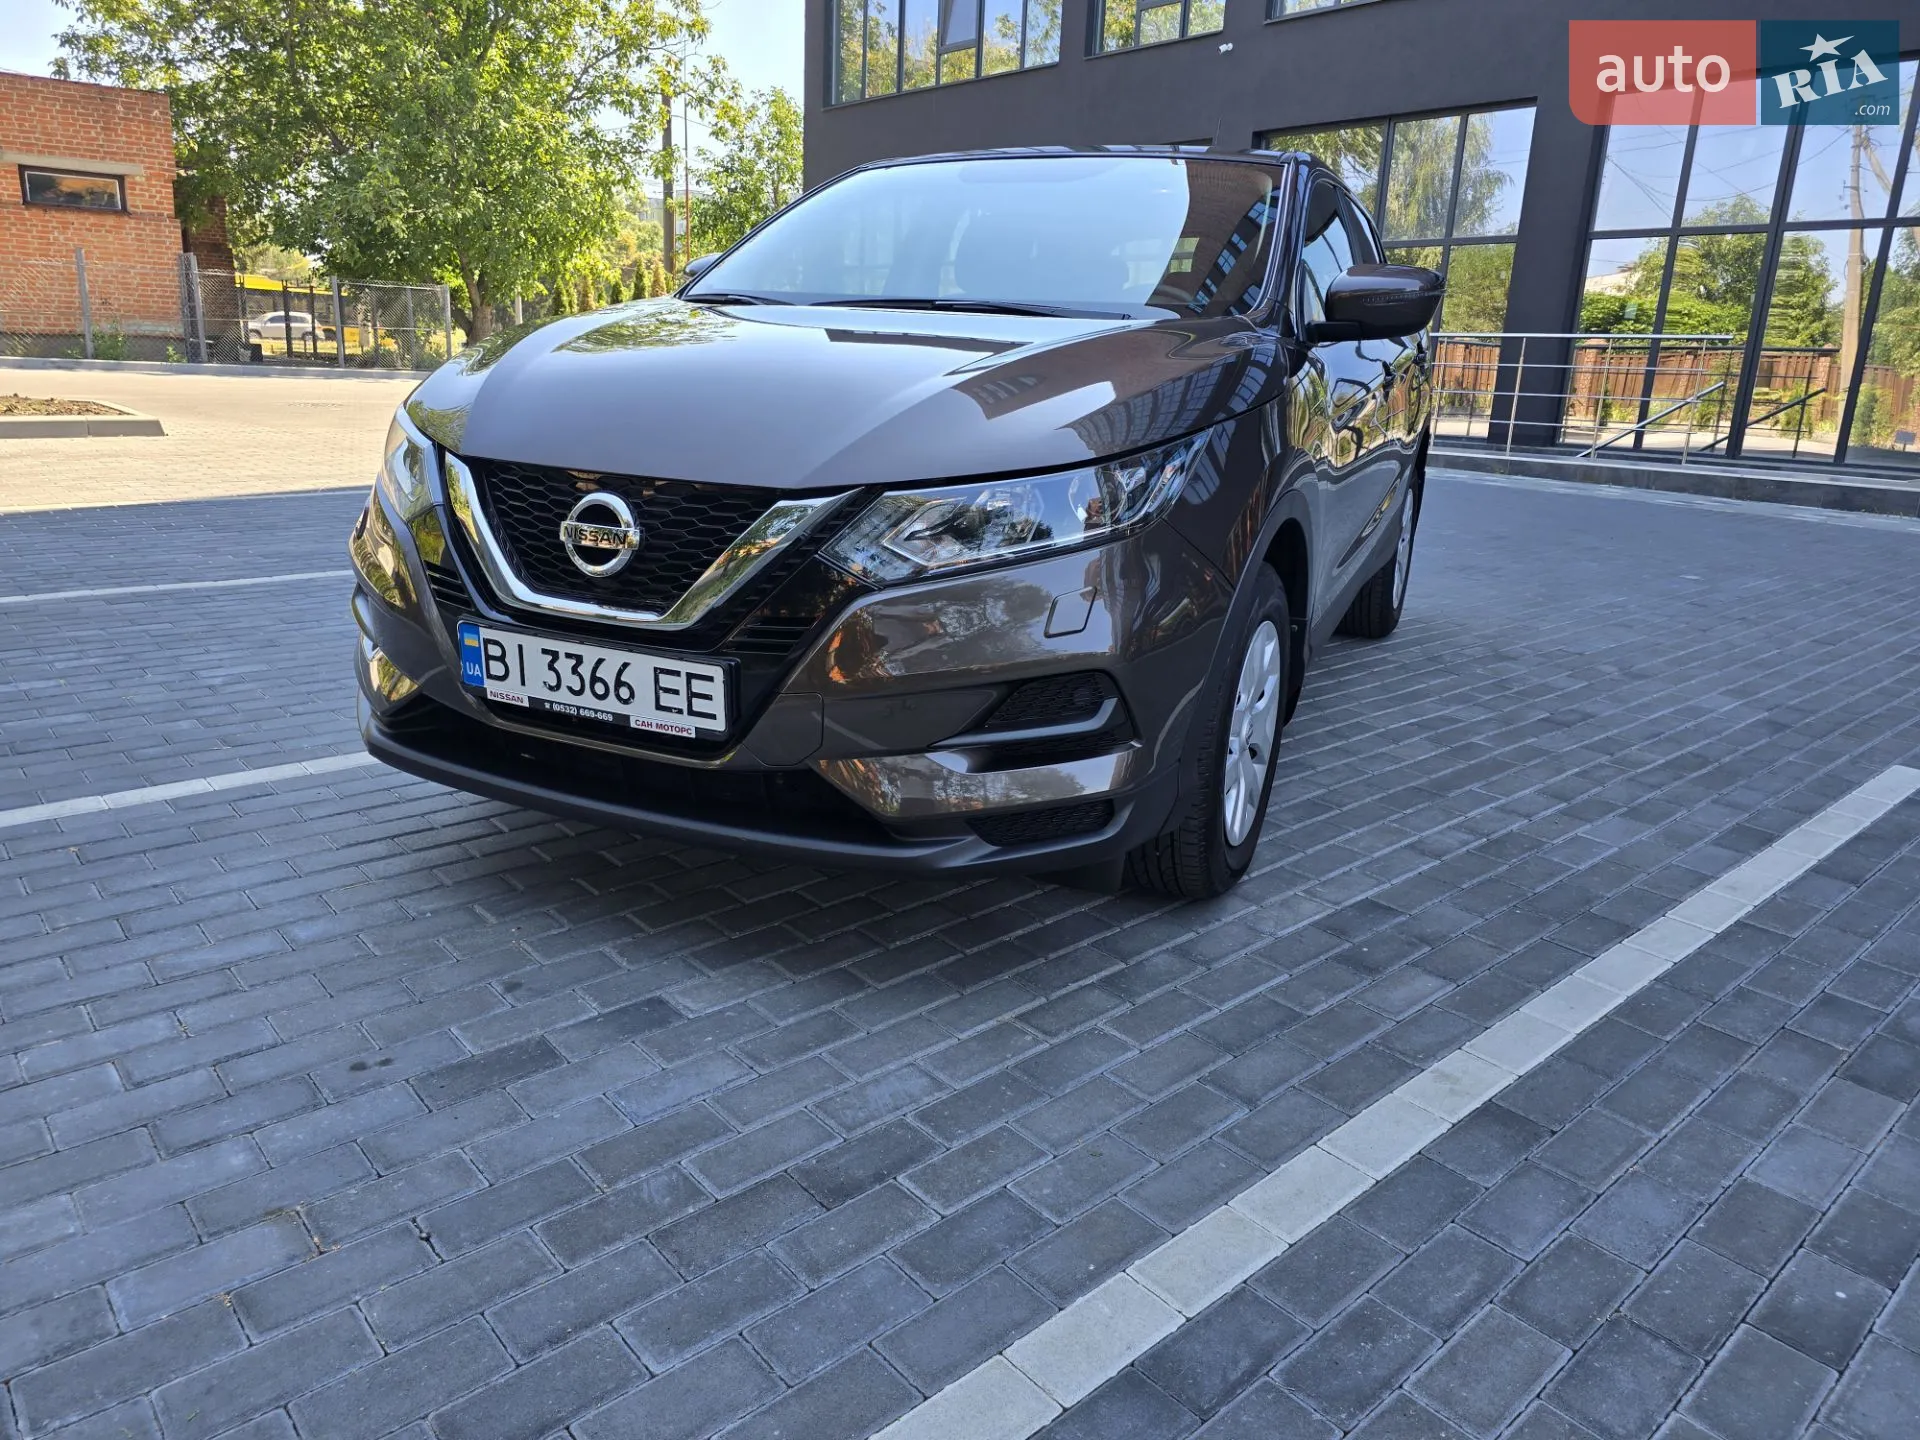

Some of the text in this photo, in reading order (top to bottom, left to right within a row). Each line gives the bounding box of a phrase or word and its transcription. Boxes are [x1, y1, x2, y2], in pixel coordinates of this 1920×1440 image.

[563, 524, 627, 545] NISSAN
[466, 661, 482, 677] UA
[483, 638, 717, 720] BI 3366 EE
[489, 690, 524, 704] NISSAN
[579, 709, 613, 722] 669-669
